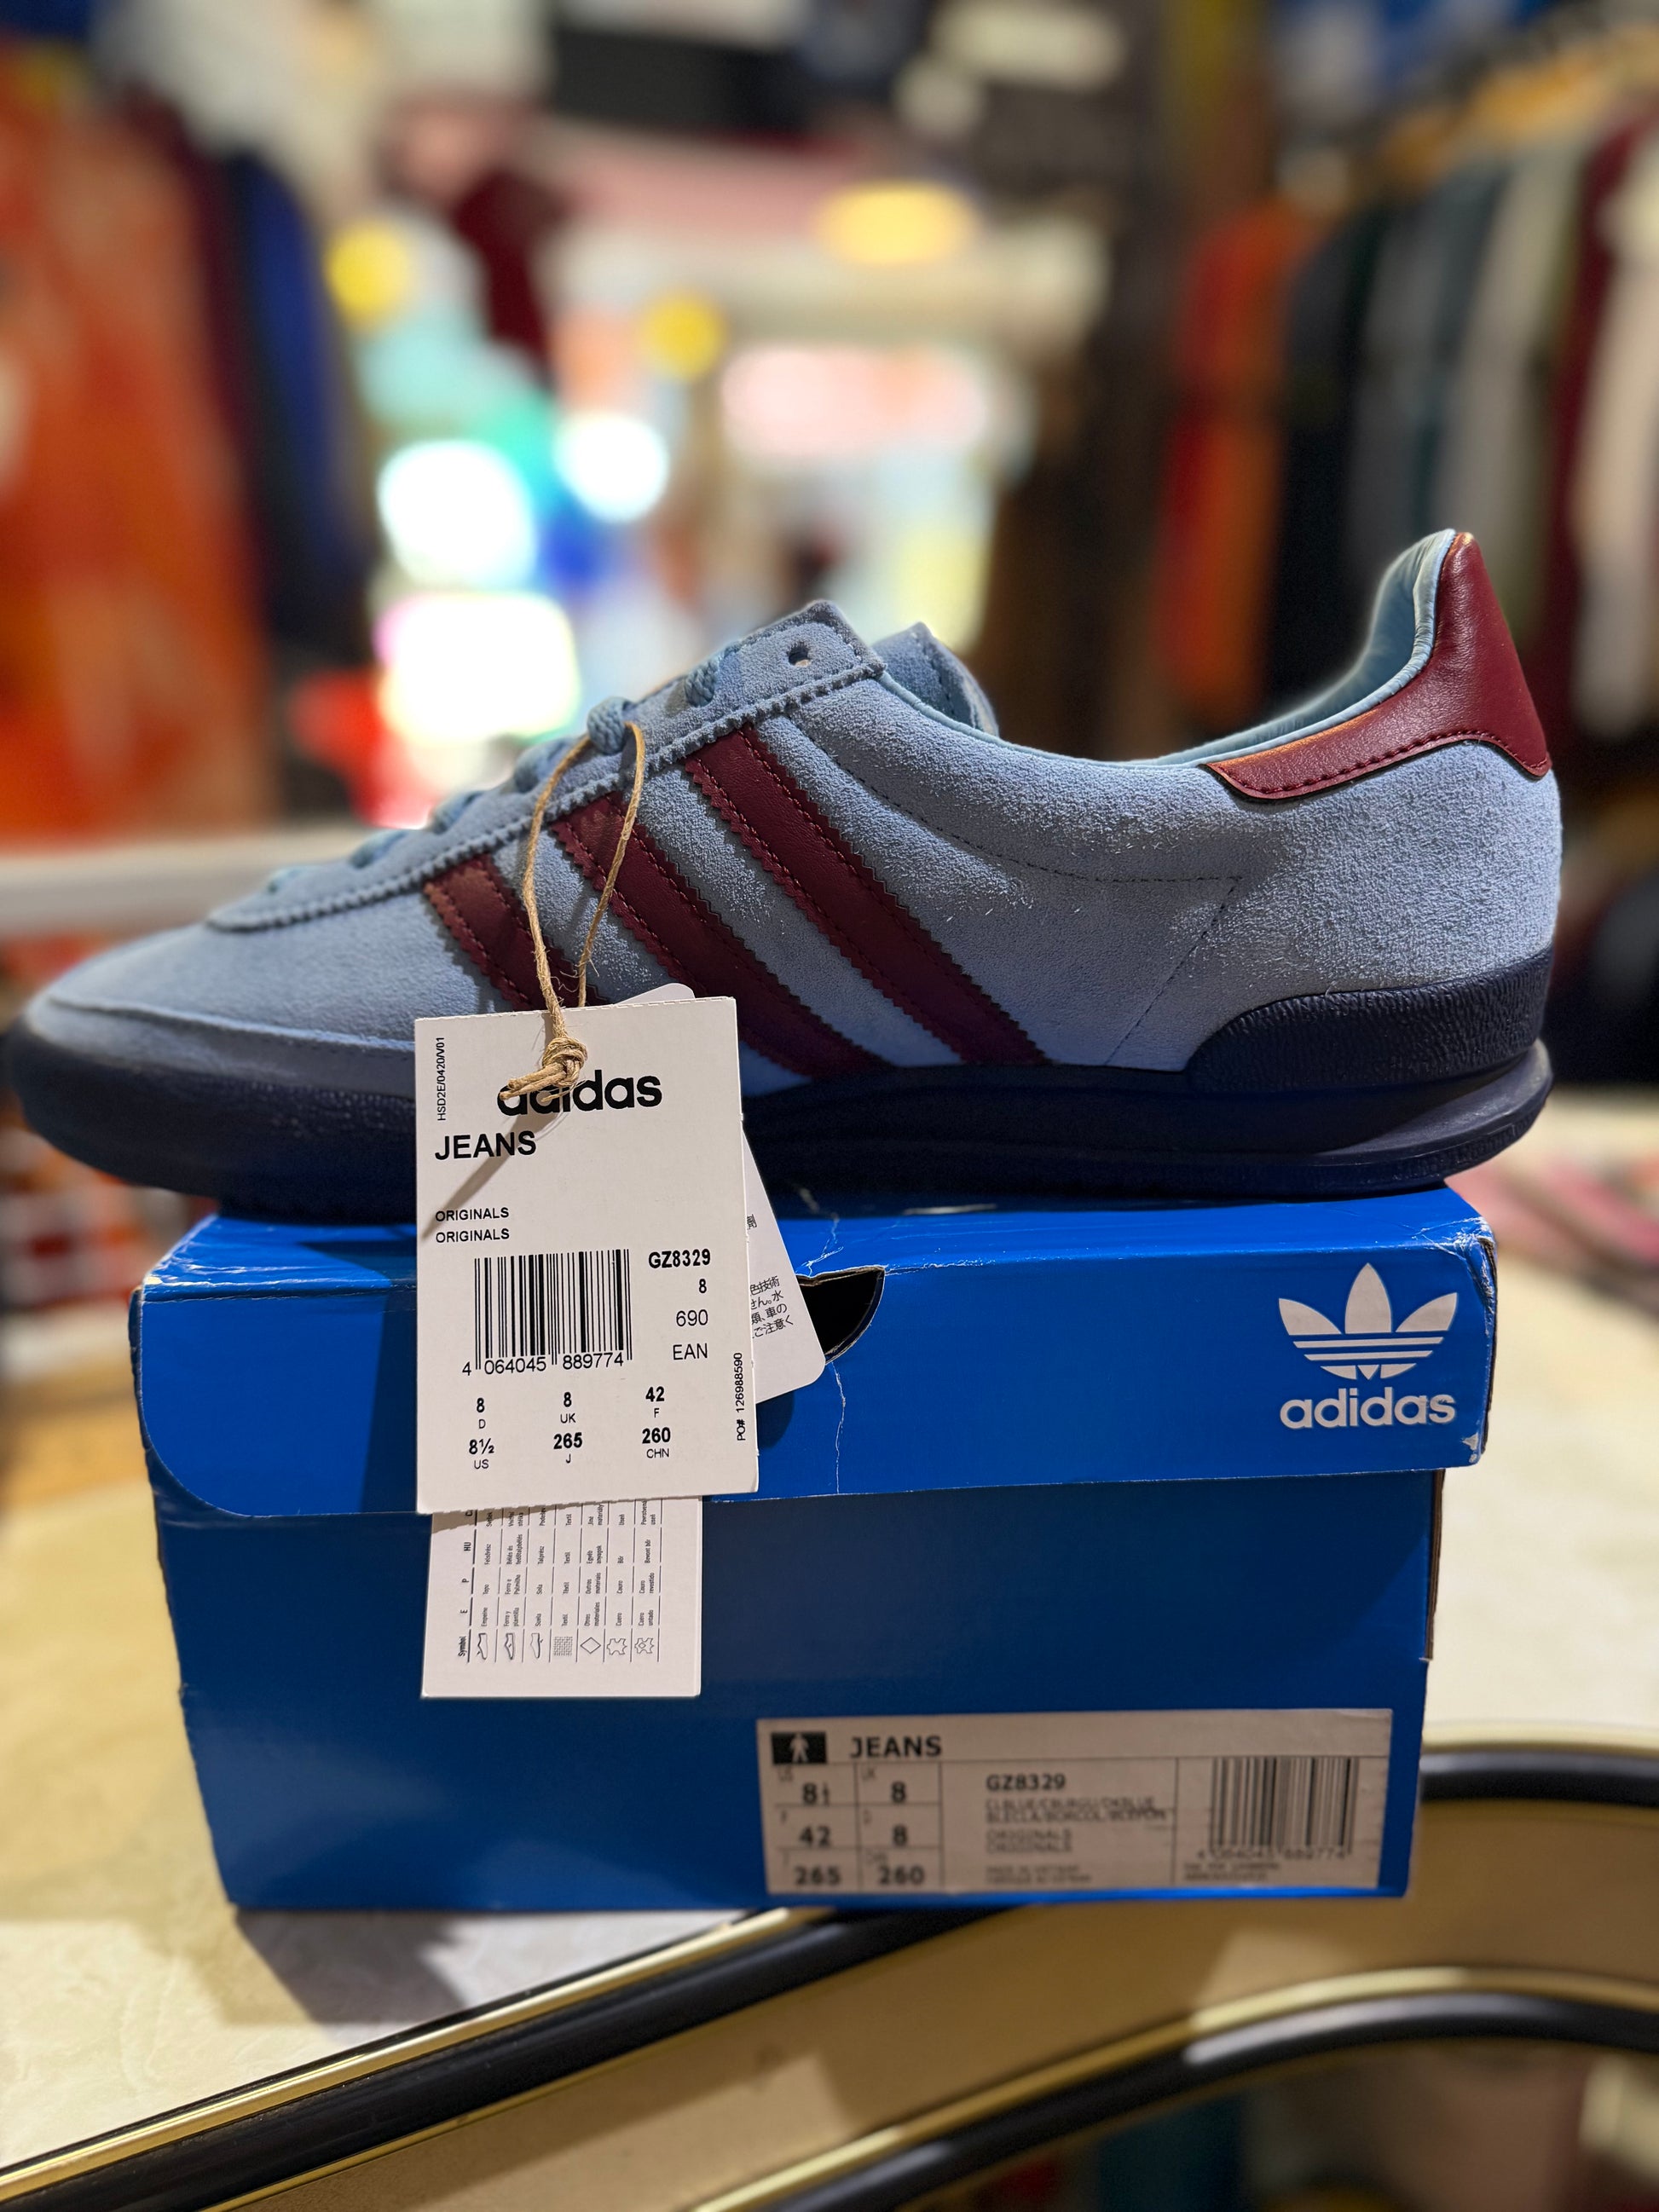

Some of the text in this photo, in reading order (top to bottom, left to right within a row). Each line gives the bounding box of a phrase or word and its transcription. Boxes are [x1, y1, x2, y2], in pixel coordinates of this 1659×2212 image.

[435, 1130, 537, 1160] JEANS
[435, 1207, 509, 1222] ORIGINALS
[436, 1228, 509, 1243] ORIGINALS
[649, 1249, 710, 1268] GZ8329
[699, 1279, 707, 1293] 8
[676, 1309, 708, 1326] 690
[673, 1343, 708, 1360] EAN
[462, 1352, 624, 1376] 4 064045 889774
[477, 1386, 664, 1412] 8 8 42
[734, 1353, 745, 1441] PO# 126988590
[1280, 1386, 1456, 1429] adidas
[479, 1408, 659, 1429] D UK F
[554, 1432, 582, 1449] 265
[642, 1427, 670, 1444] 260
[474, 1448, 669, 1470] US J CHN
[464, 1542, 471, 1551] HU
[458, 1636, 467, 1656] Symbol
[850, 1736, 943, 1759] JEANS
[891, 1781, 907, 1805] 8
[986, 1773, 1066, 1791] GZ8329
[799, 1824, 908, 1848] 42 8
[795, 1865, 841, 1886] 265
[879, 1865, 925, 1885] 260
